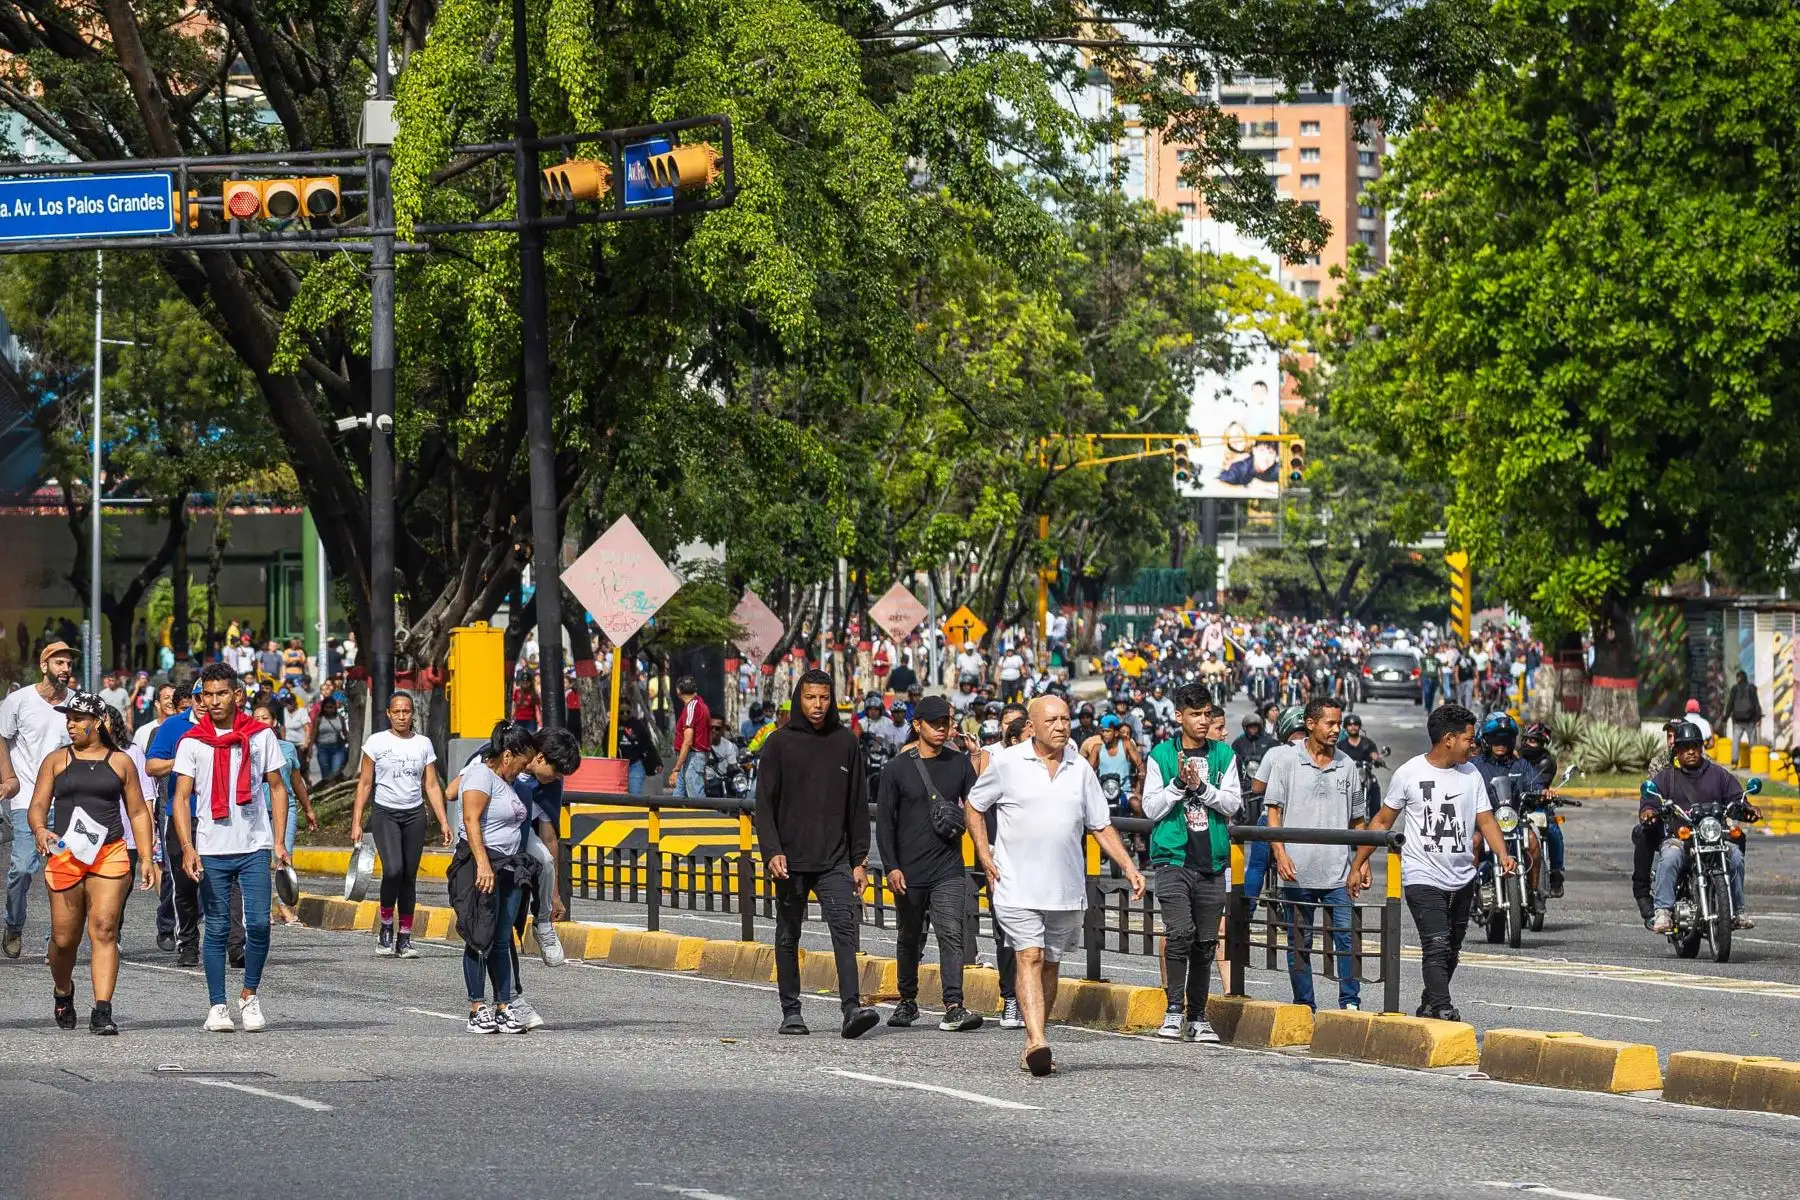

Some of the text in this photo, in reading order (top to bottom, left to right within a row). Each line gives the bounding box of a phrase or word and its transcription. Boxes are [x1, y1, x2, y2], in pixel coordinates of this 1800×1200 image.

[14, 199, 35, 217] Av.
[38, 197, 64, 216] Los
[67, 196, 105, 214] Palos
[107, 193, 165, 213] Grandes
